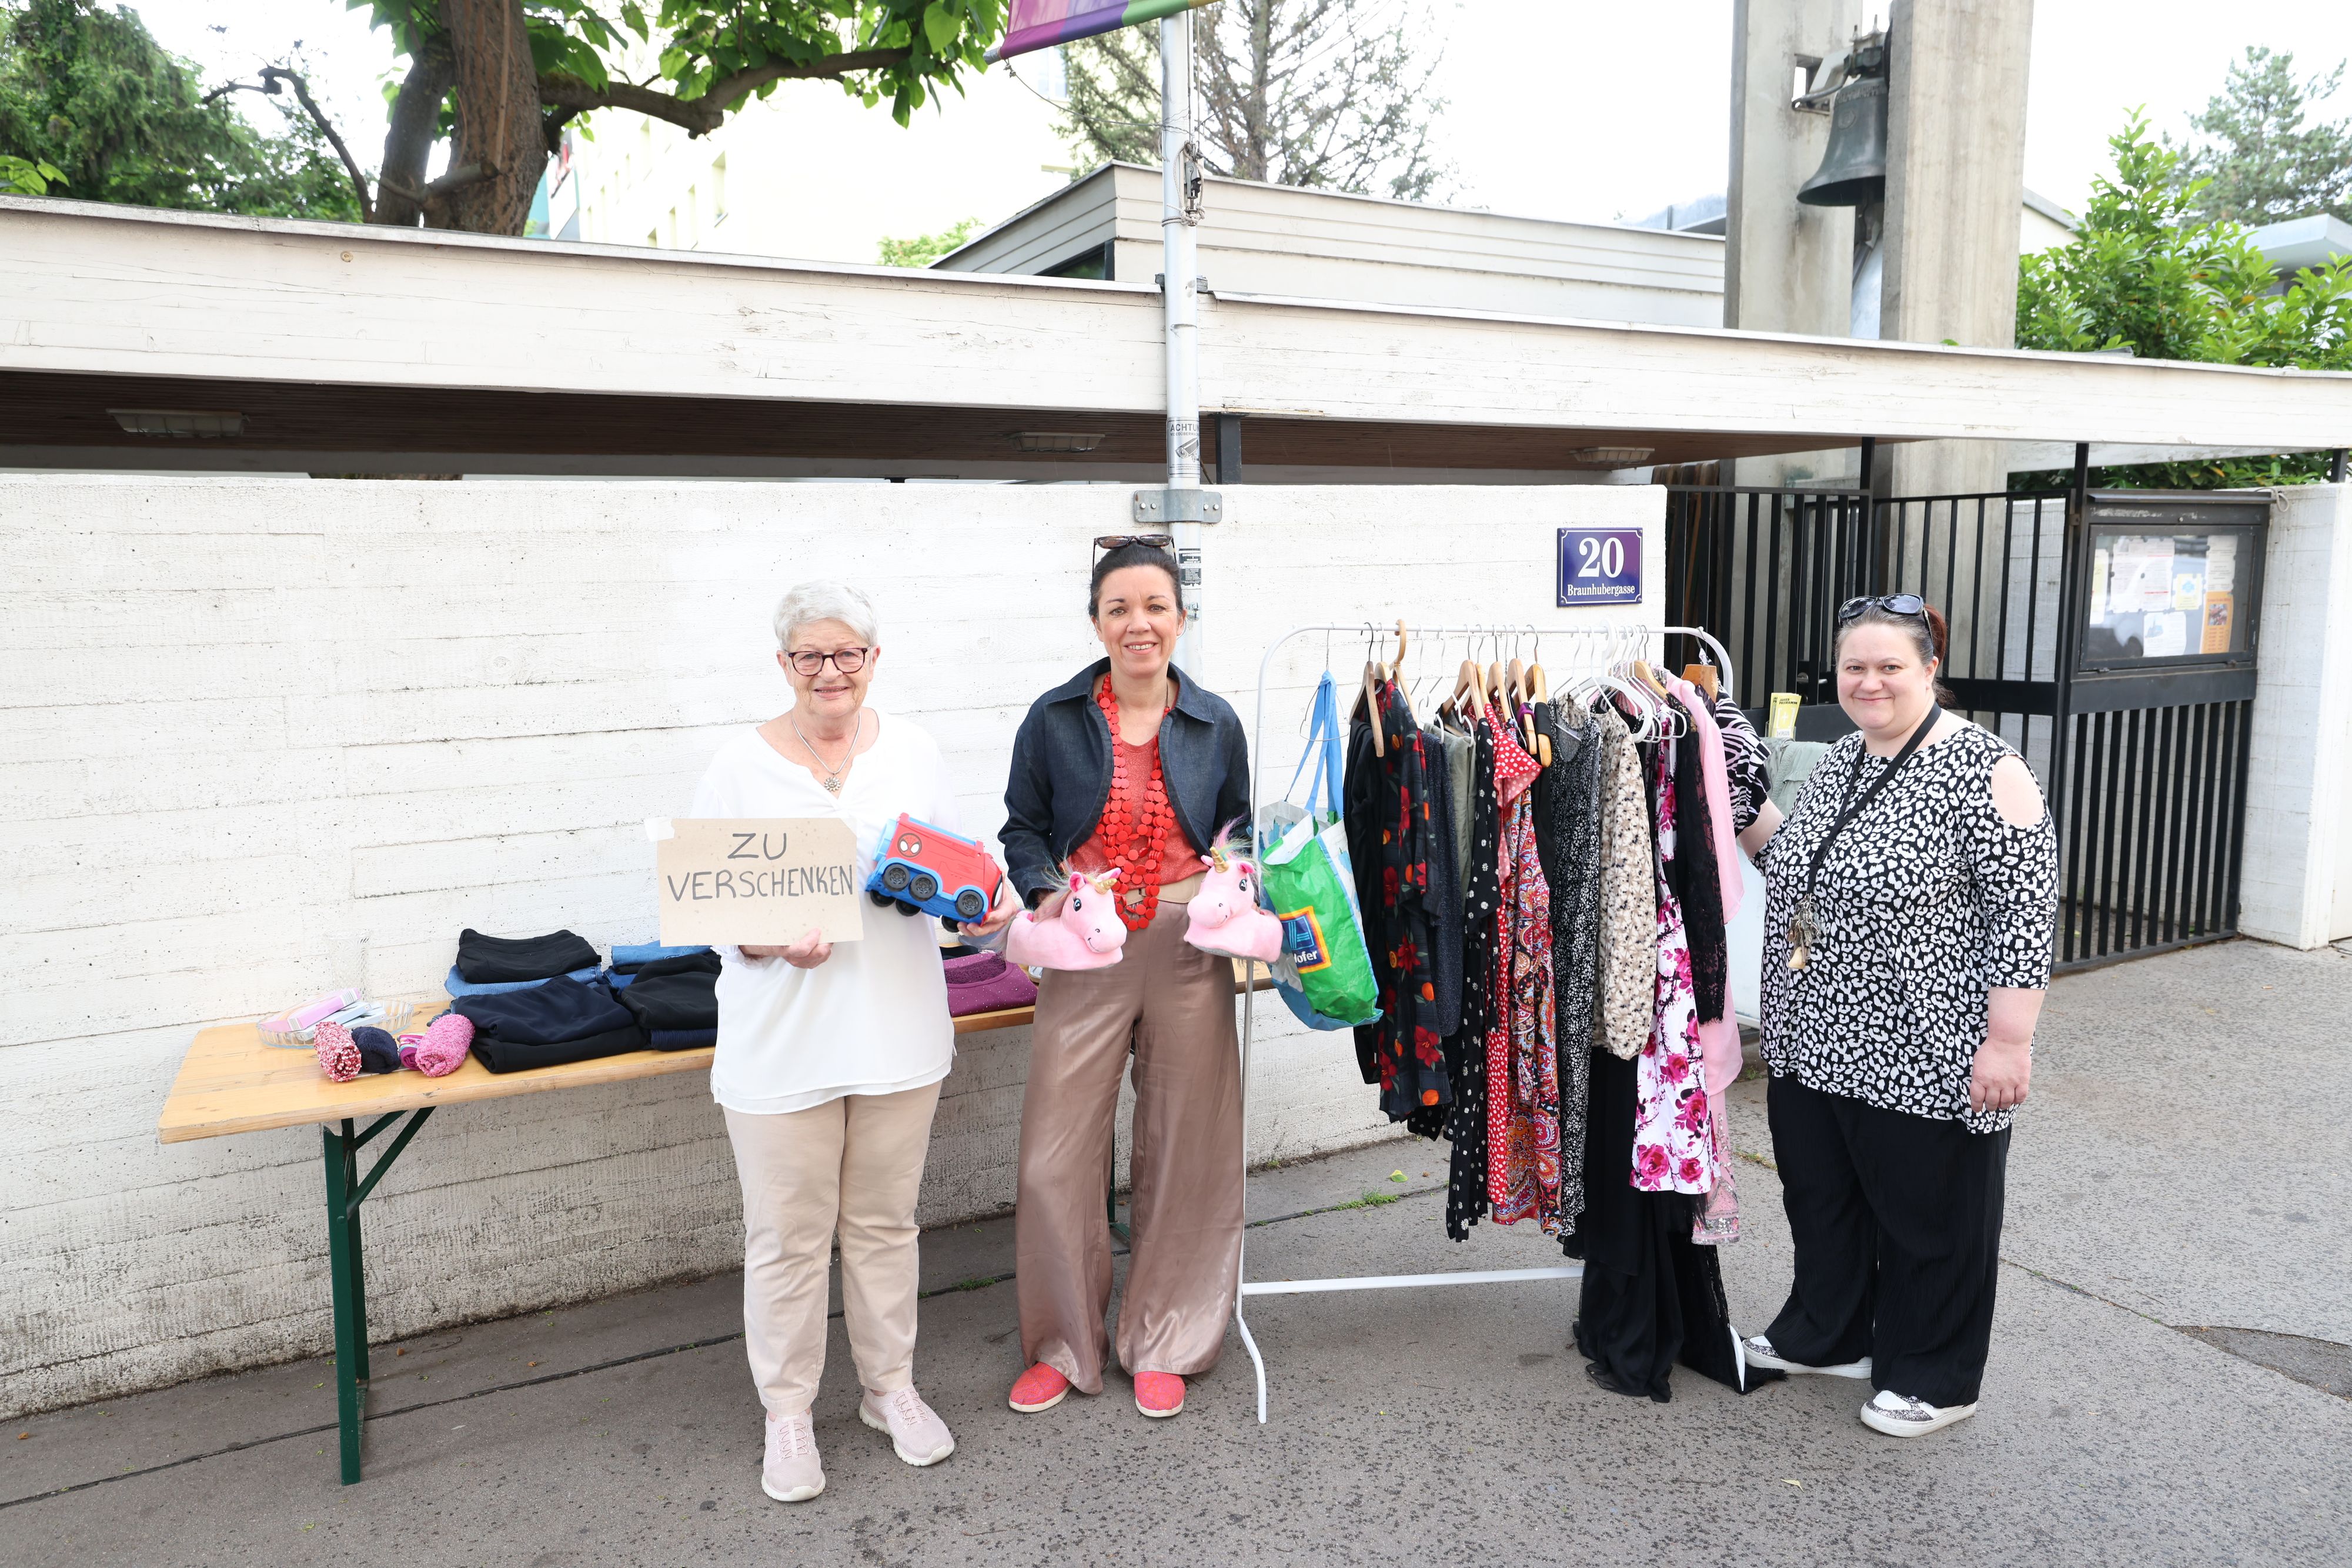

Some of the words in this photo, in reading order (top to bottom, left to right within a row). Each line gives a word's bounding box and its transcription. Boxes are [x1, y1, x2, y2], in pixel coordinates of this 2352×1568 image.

[1578, 537, 1624, 578] 20
[1567, 583, 1635, 597] Braunhubergasse
[727, 833, 787, 860] ZU
[667, 864, 853, 902] VERSCHENKEN
